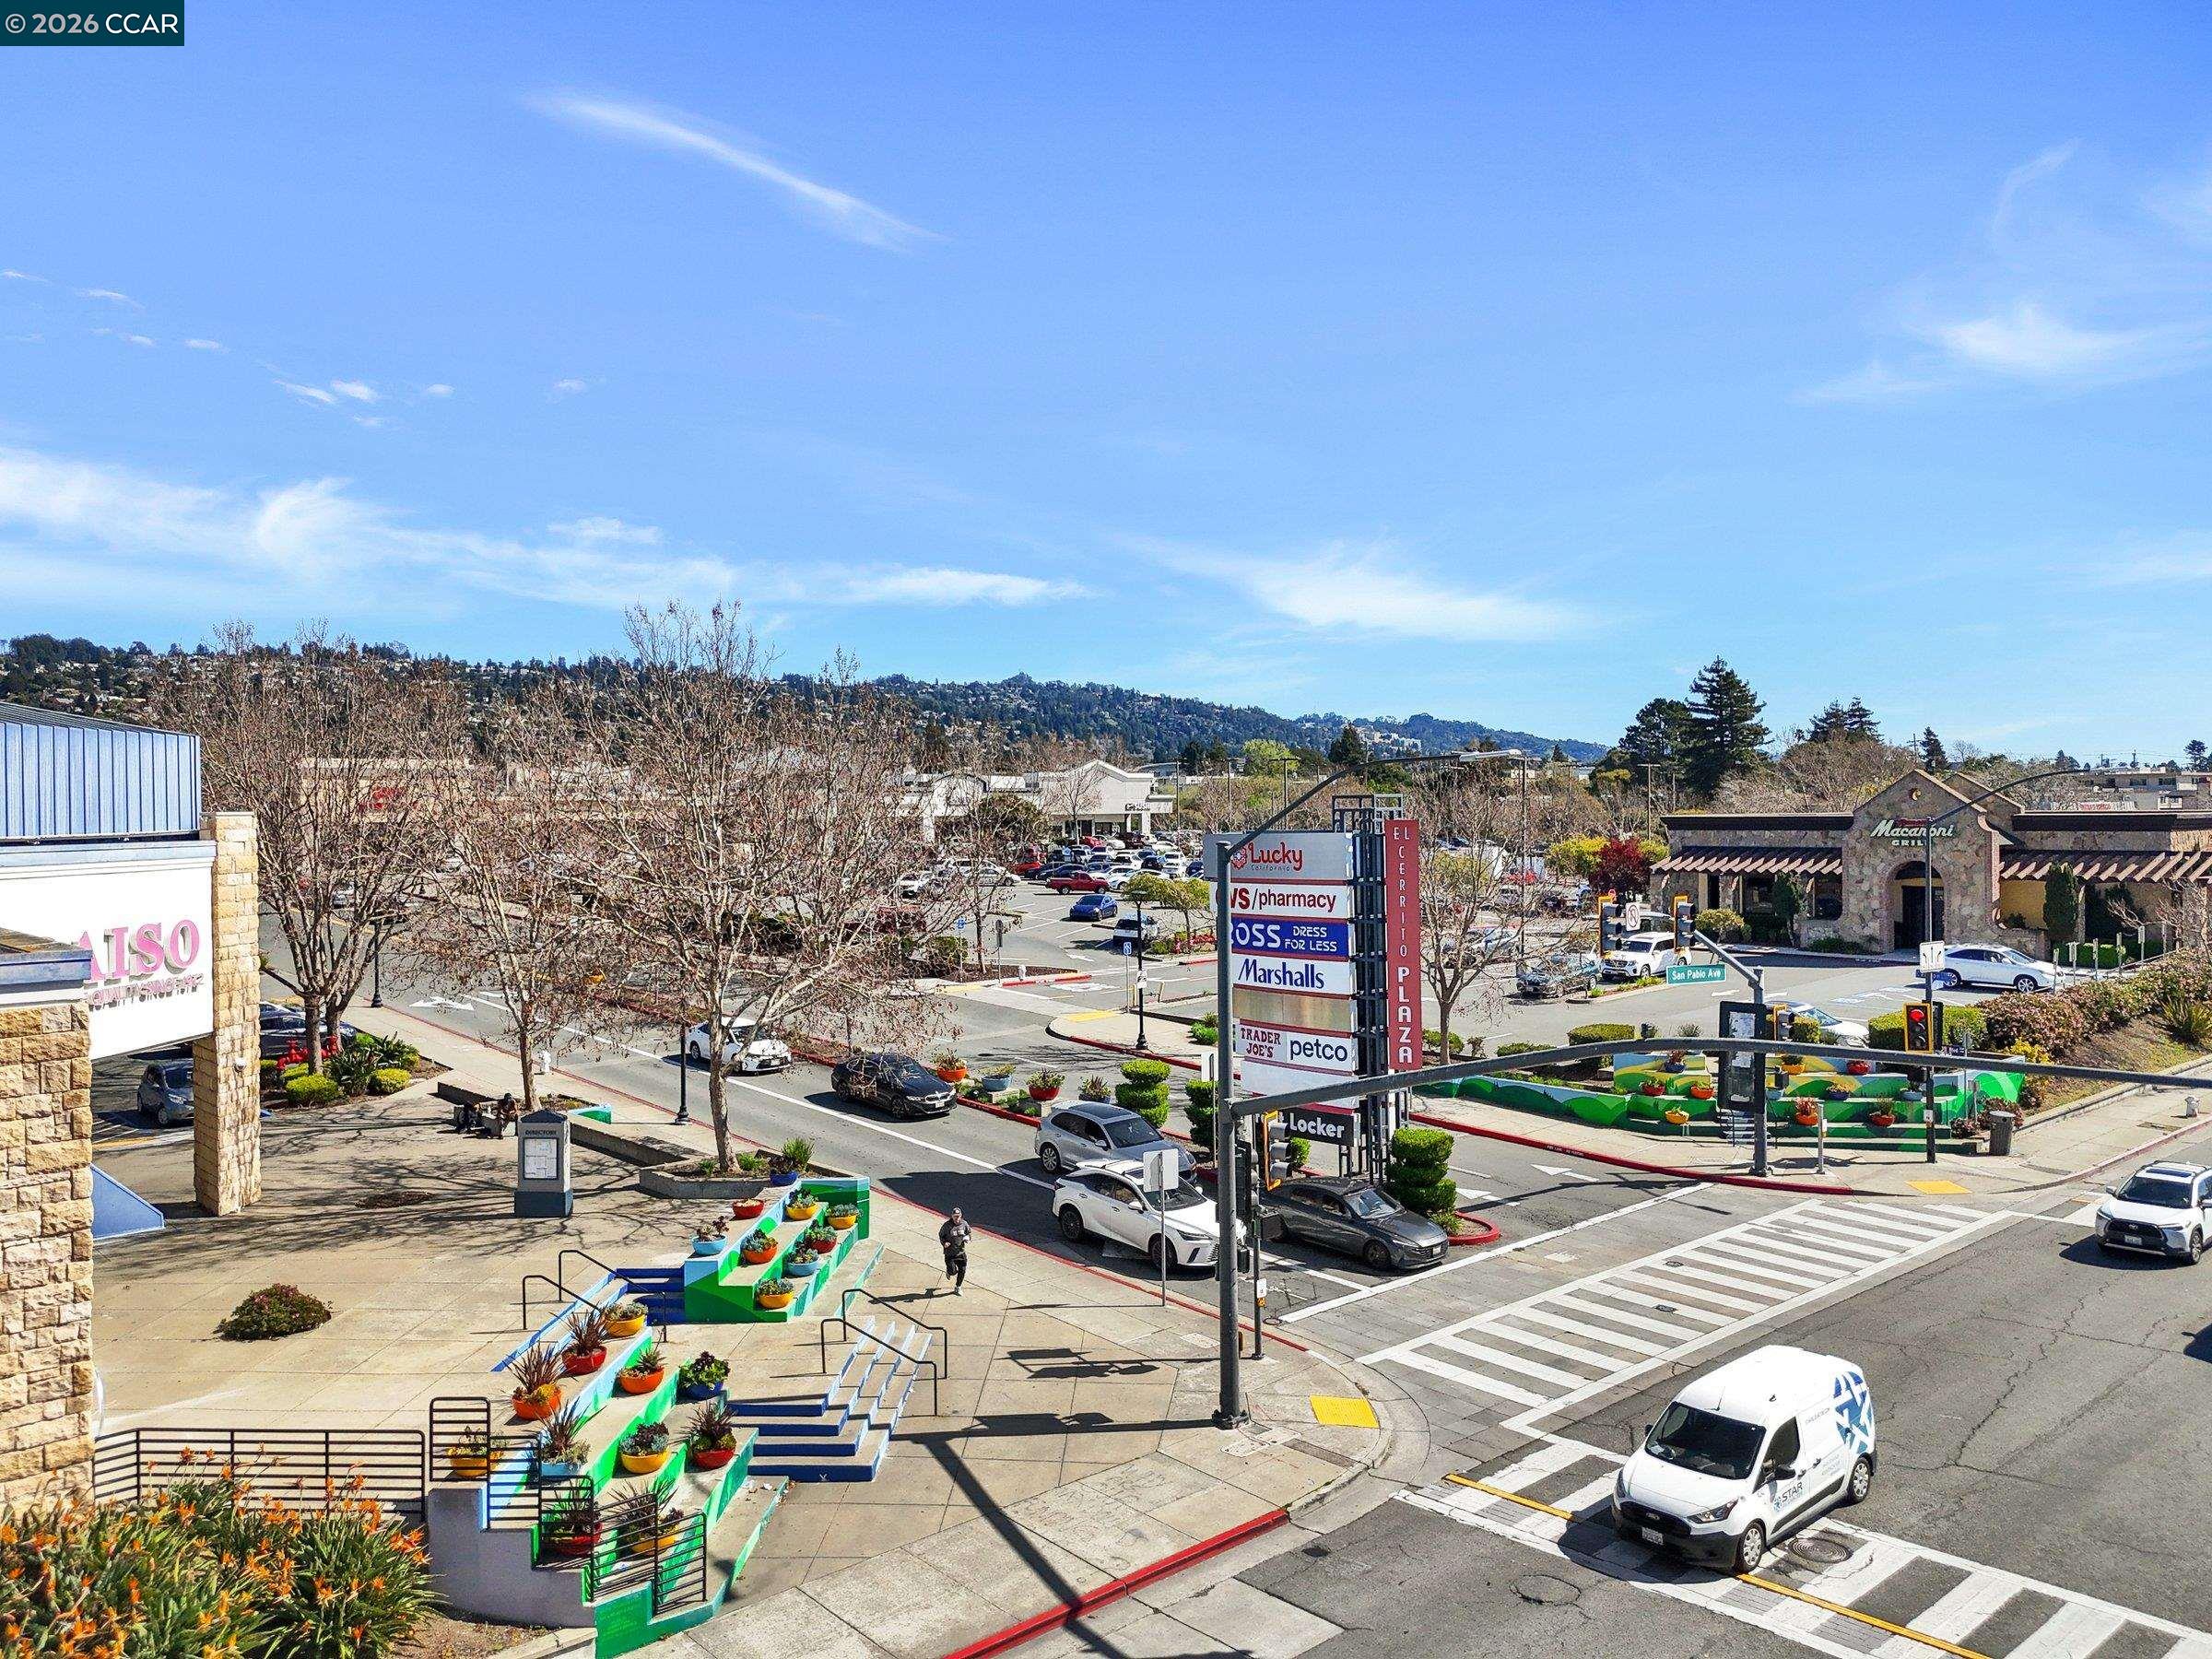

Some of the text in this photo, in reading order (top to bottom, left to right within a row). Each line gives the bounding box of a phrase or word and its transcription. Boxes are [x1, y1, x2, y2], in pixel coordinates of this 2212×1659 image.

[1393, 826, 1410, 841] EL
[1869, 819, 1955, 837] Macaroni
[1247, 840, 1304, 873] Lucky
[1216, 886, 1337, 913] VS/pharmacy
[1398, 844, 1408, 958] CERRITO
[1230, 922, 1281, 948] OSS
[1292, 925, 1327, 938] DRESS
[1284, 939, 1338, 953] FOR LESS
[1237, 958, 1325, 990] Marshalls
[1671, 968, 1722, 981] San Pablo Ave
[1396, 965, 1413, 1064] PLAZA
[1240, 1027, 1282, 1046] TRADER
[1245, 1041, 1274, 1059] JOE'S
[1289, 1038, 1348, 1063] petco
[1289, 1112, 1346, 1139] Locker
